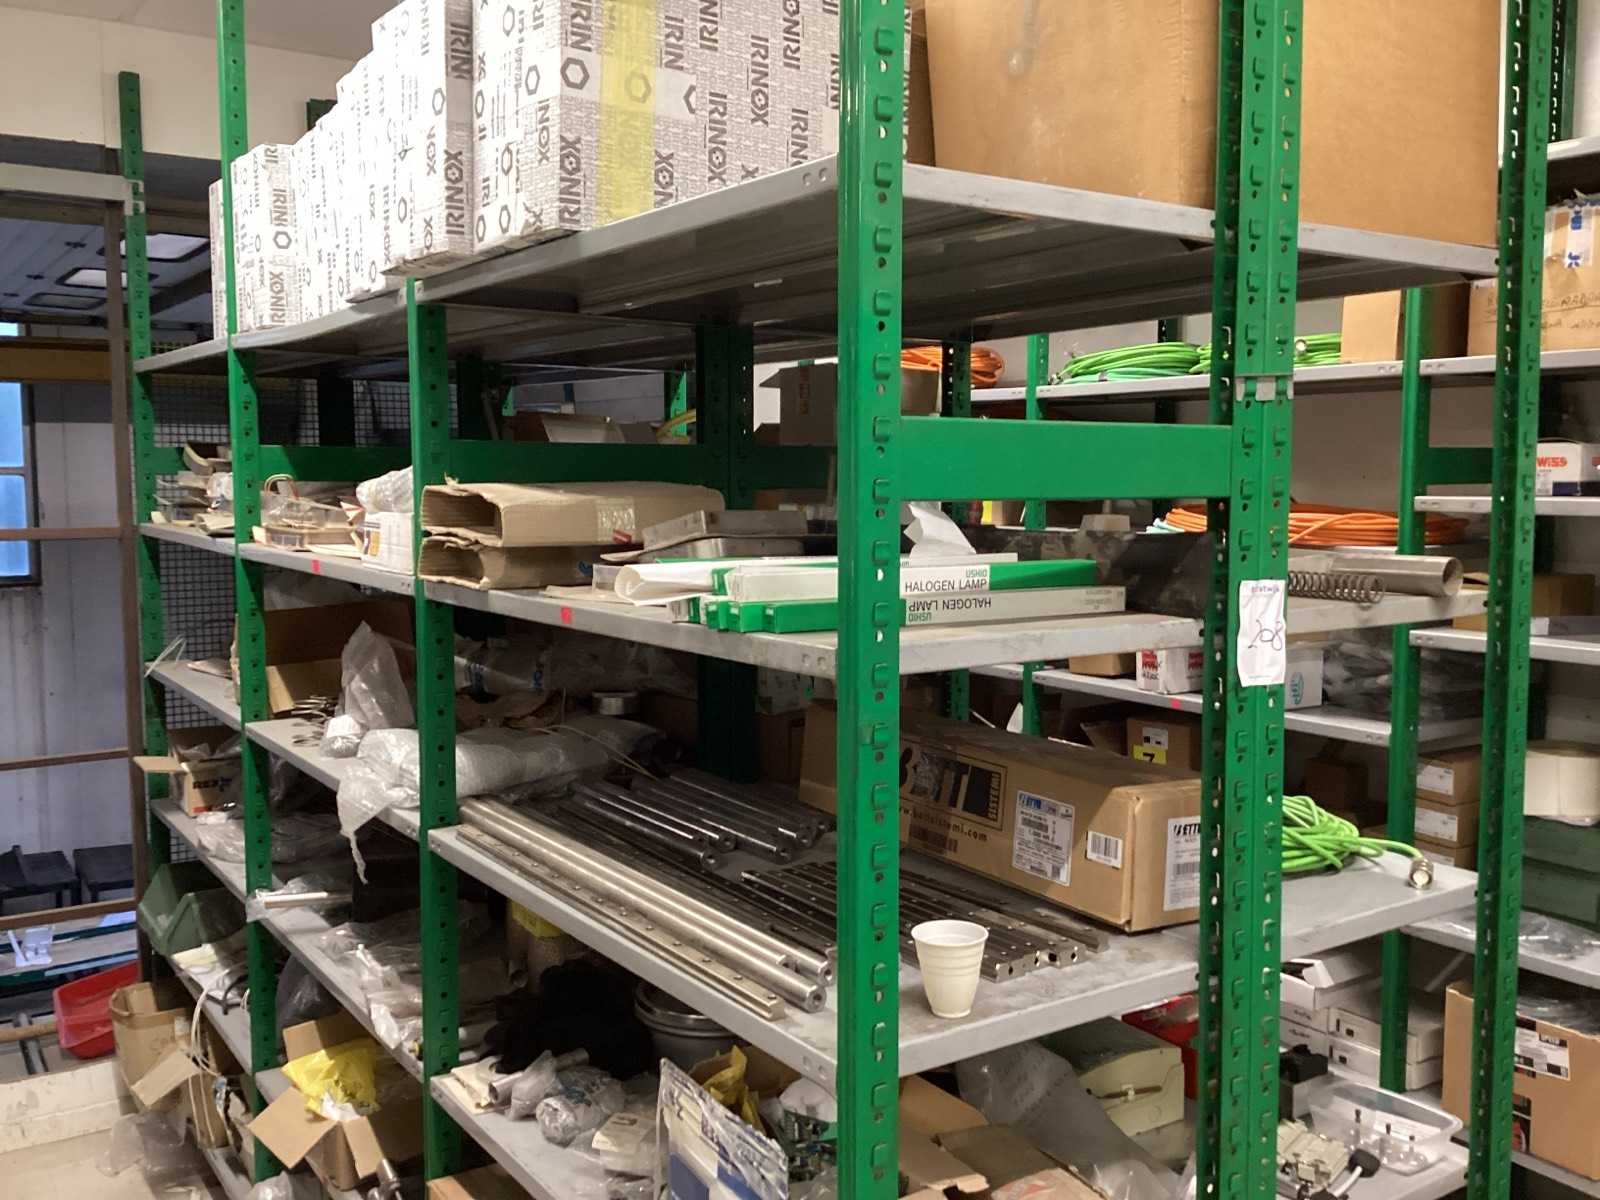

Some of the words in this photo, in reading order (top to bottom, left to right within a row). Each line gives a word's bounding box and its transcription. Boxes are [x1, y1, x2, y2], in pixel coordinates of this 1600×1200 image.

[449, 21, 472, 80] IRIN
[569, 0, 592, 52] RIN
[750, 34, 769, 127] IRINOX
[708, 91, 727, 186] IRINOX
[790, 108, 808, 167] IRIN
[272, 188, 288, 227] IRIN
[444, 149, 465, 236] IRINOX
[905, 579, 955, 592] HALOGEN
[959, 578, 987, 590] LAMP
[908, 600, 938, 612] LAMP
[942, 597, 992, 611] HALOGEN
